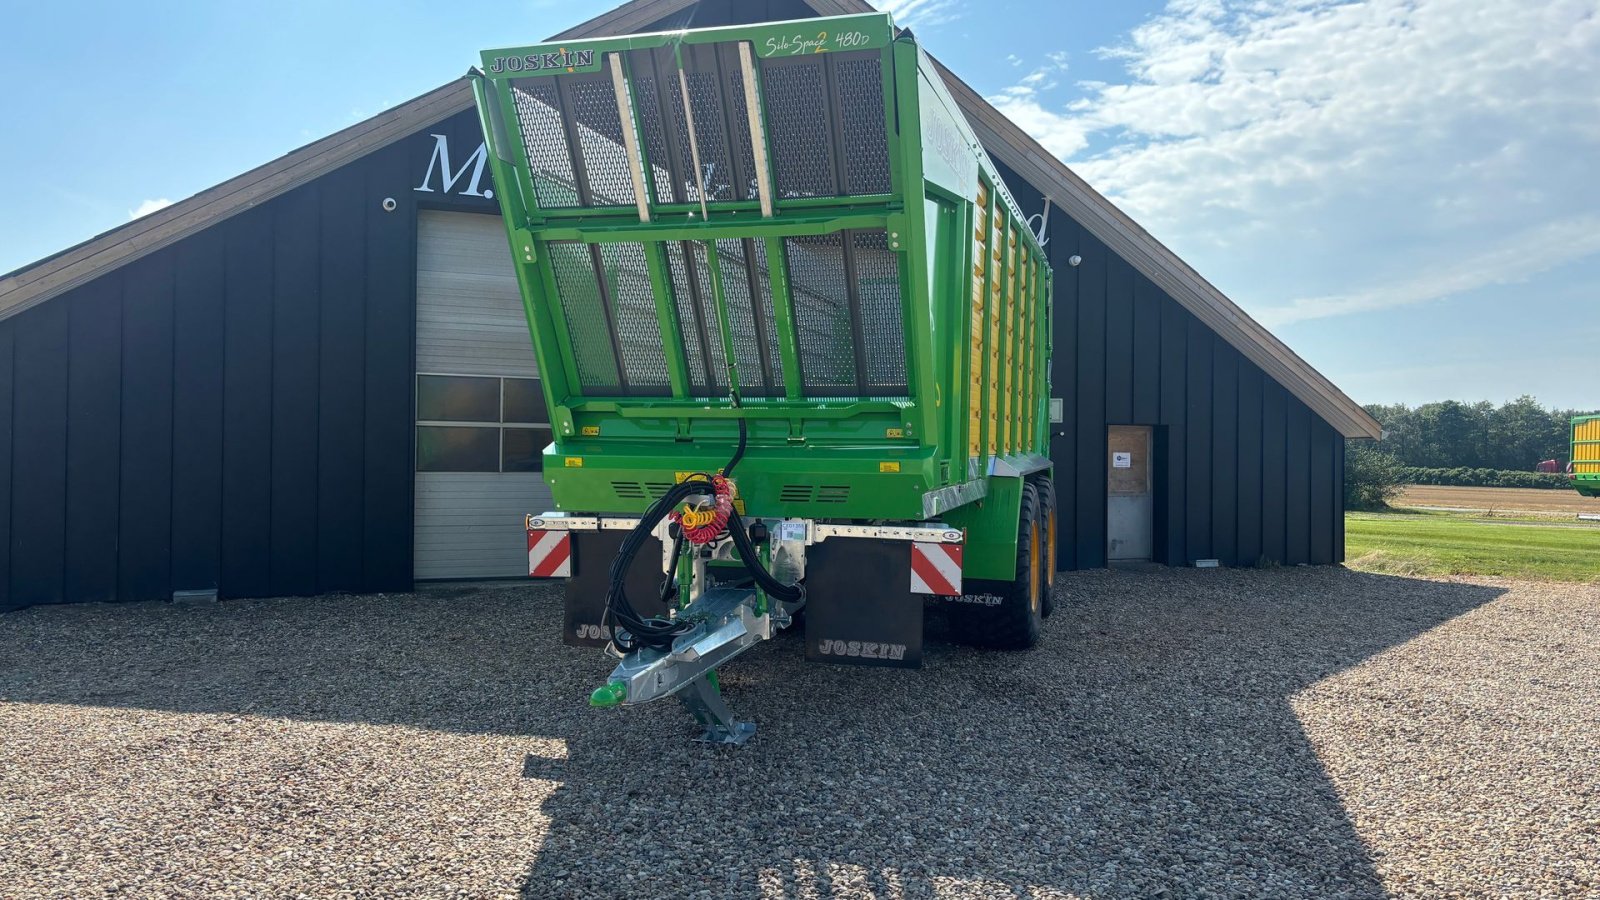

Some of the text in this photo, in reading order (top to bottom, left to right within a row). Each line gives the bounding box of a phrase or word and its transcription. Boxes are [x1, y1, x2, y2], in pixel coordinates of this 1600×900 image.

[765, 34, 827, 57] Silo-Space
[490, 49, 594, 73] JOSKIN
[819, 639, 907, 660] JOSKIN
